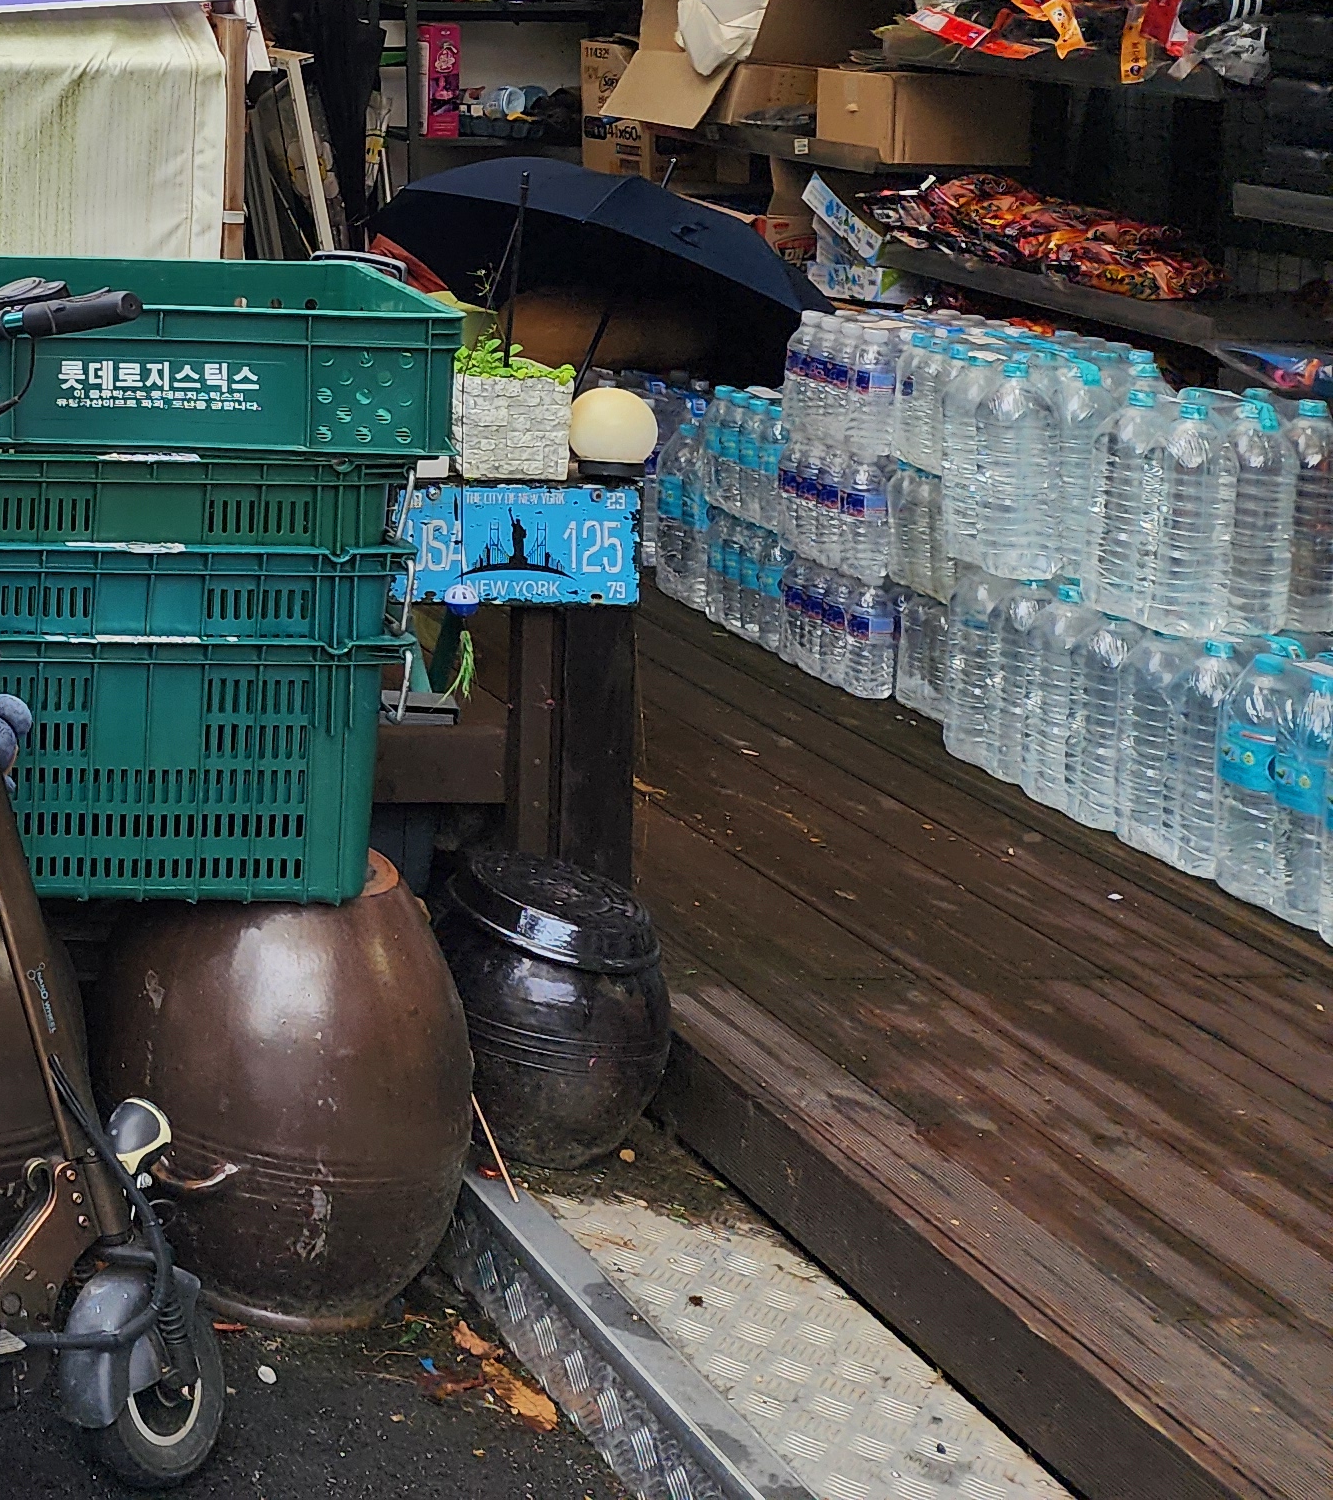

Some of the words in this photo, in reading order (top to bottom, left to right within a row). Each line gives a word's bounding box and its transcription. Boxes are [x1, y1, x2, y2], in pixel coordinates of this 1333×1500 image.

[57, 360, 260, 393] 롯데로지스틱스
[73, 389, 85, 399] 이
[466, 491, 483, 504] THE
[484, 492, 503, 504] CITY
[505, 492, 518, 504] OF
[519, 492, 540, 505] NEW
[541, 492, 566, 505] YORK
[606, 492, 626, 510] 23
[408, 519, 468, 573] USA
[562, 520, 624, 574] 125
[466, 579, 509, 598] NEW
[512, 579, 562, 599] YORK
[606, 581, 626, 600] 79
